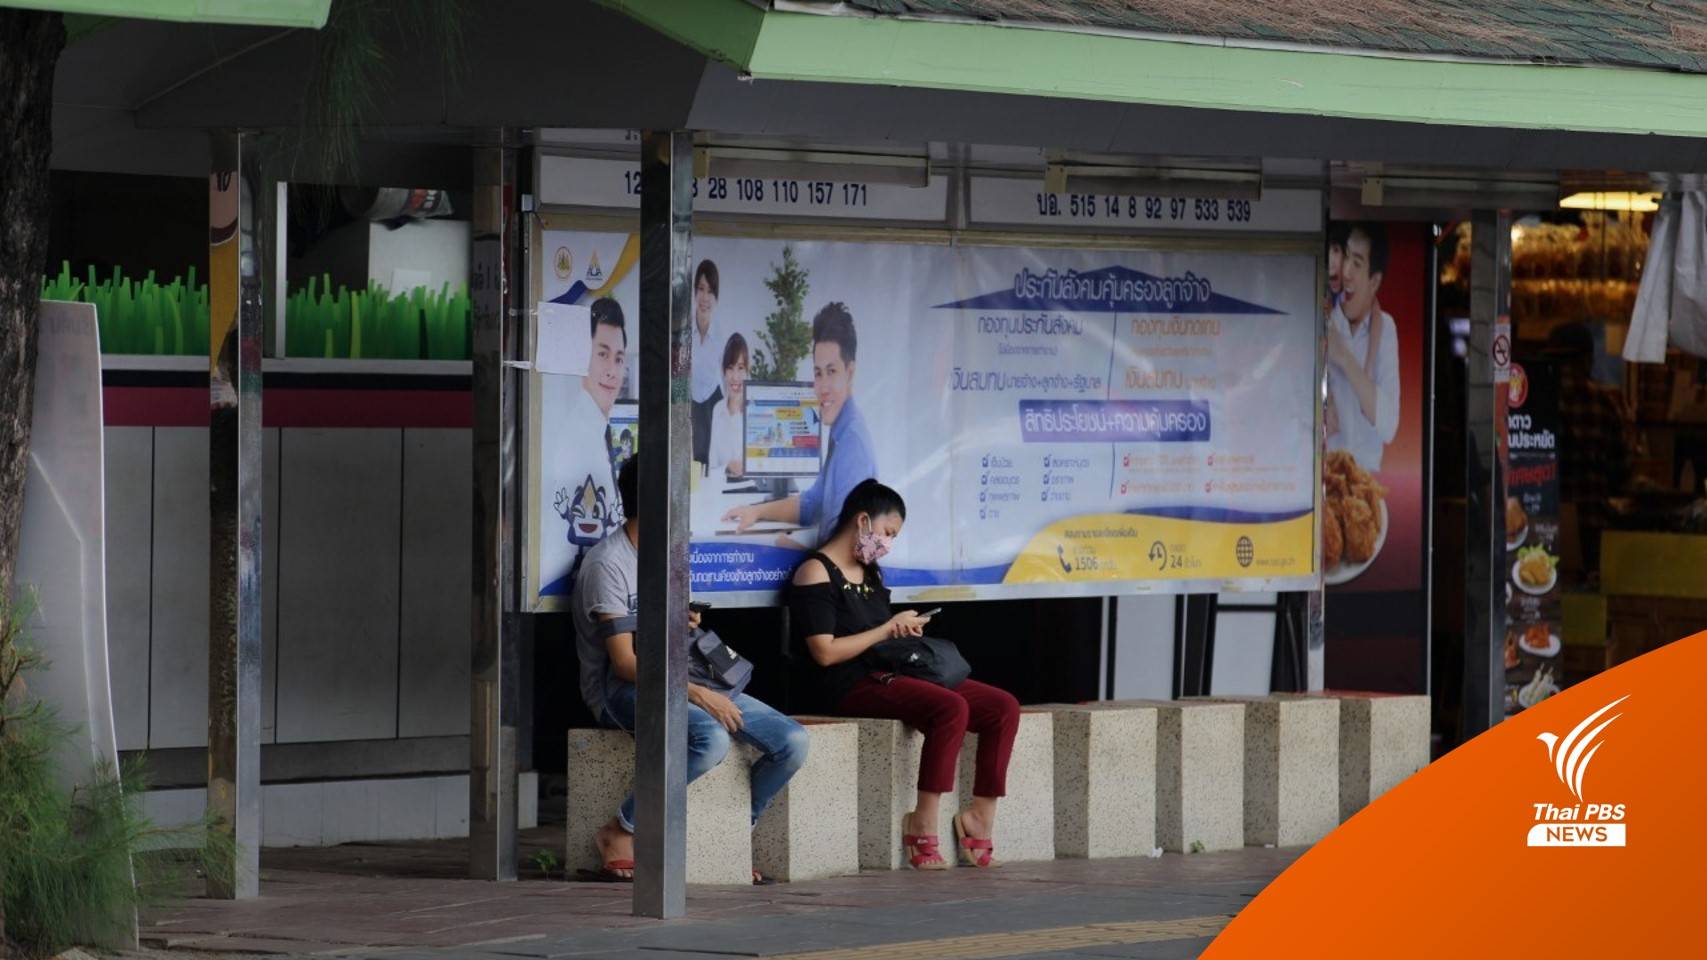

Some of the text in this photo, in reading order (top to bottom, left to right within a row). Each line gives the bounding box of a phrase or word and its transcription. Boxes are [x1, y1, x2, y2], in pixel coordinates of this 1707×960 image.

[708, 178, 727, 199] 28
[737, 179, 764, 202] 108
[772, 180, 798, 203] 110
[808, 182, 833, 205] 157
[843, 184, 867, 206] 171
[1037, 193, 1251, 222] ปอ. 515 14 8 92 97 533 539
[1014, 268, 1211, 309] ประกันสังคมคุ้มครองลูกจ้าง
[977, 311, 1083, 338] กองทุนประกันสังคม
[952, 367, 1006, 391] งินสมทบ
[1074, 557, 1098, 571] 1506
[1170, 555, 1183, 569] 24
